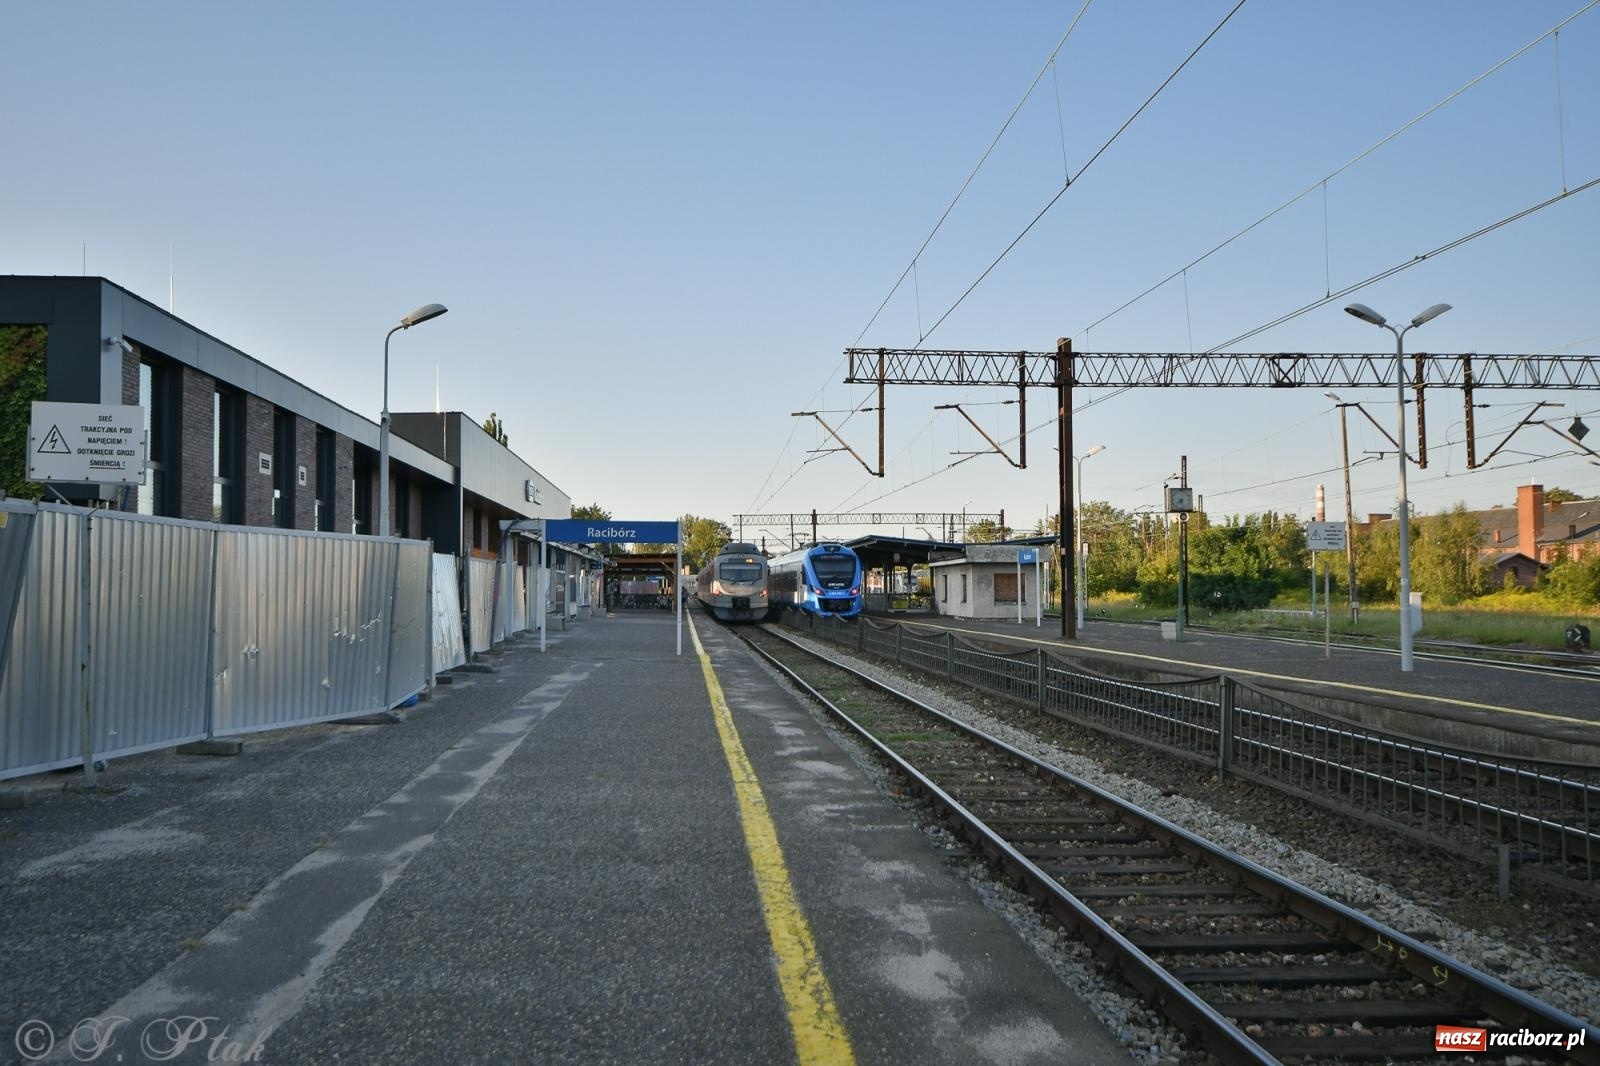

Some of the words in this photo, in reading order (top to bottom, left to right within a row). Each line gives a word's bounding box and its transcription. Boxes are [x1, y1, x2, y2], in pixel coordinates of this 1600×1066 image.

[80, 425, 117, 434] TRAKCYJNA
[87, 437, 122, 446] NAPIĘCIEM
[77, 448, 115, 456] DOTKNIĘCIE
[89, 458, 121, 468] ŚMIERCIĄ
[587, 527, 636, 538] Racibórz
